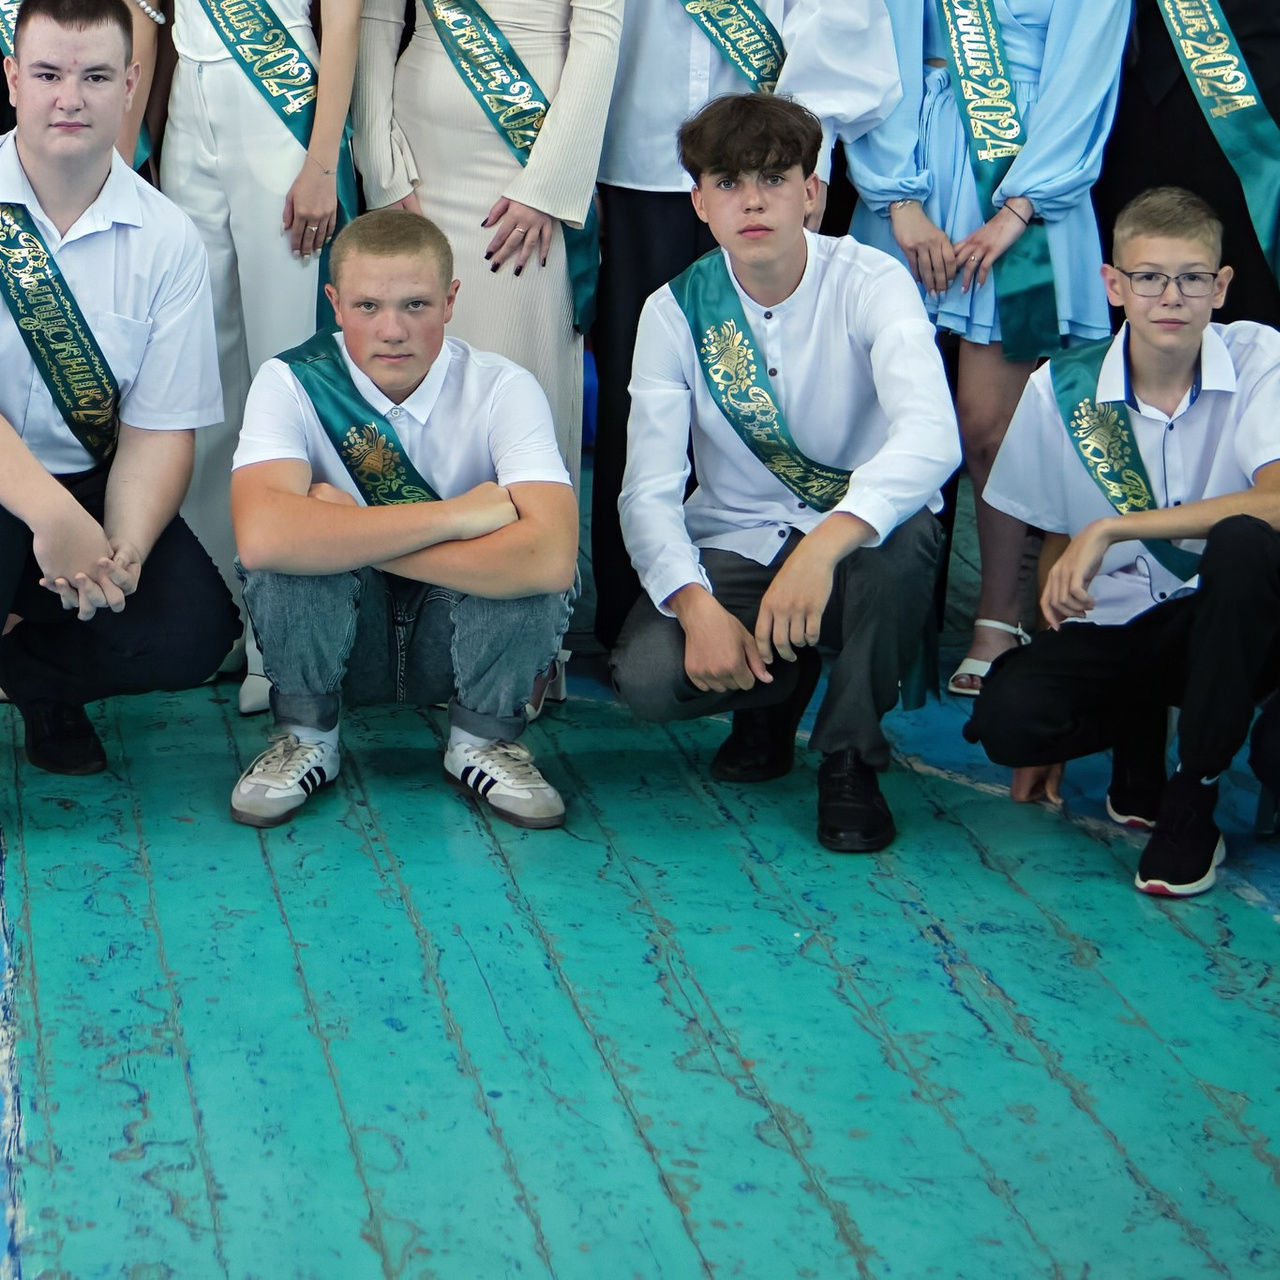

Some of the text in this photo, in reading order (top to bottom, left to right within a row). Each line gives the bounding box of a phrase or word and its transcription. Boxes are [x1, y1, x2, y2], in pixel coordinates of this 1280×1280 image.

[236, 29, 317, 115] 2024
[1180, 32, 1257, 119] 2024
[960, 78, 1022, 162] 2024
